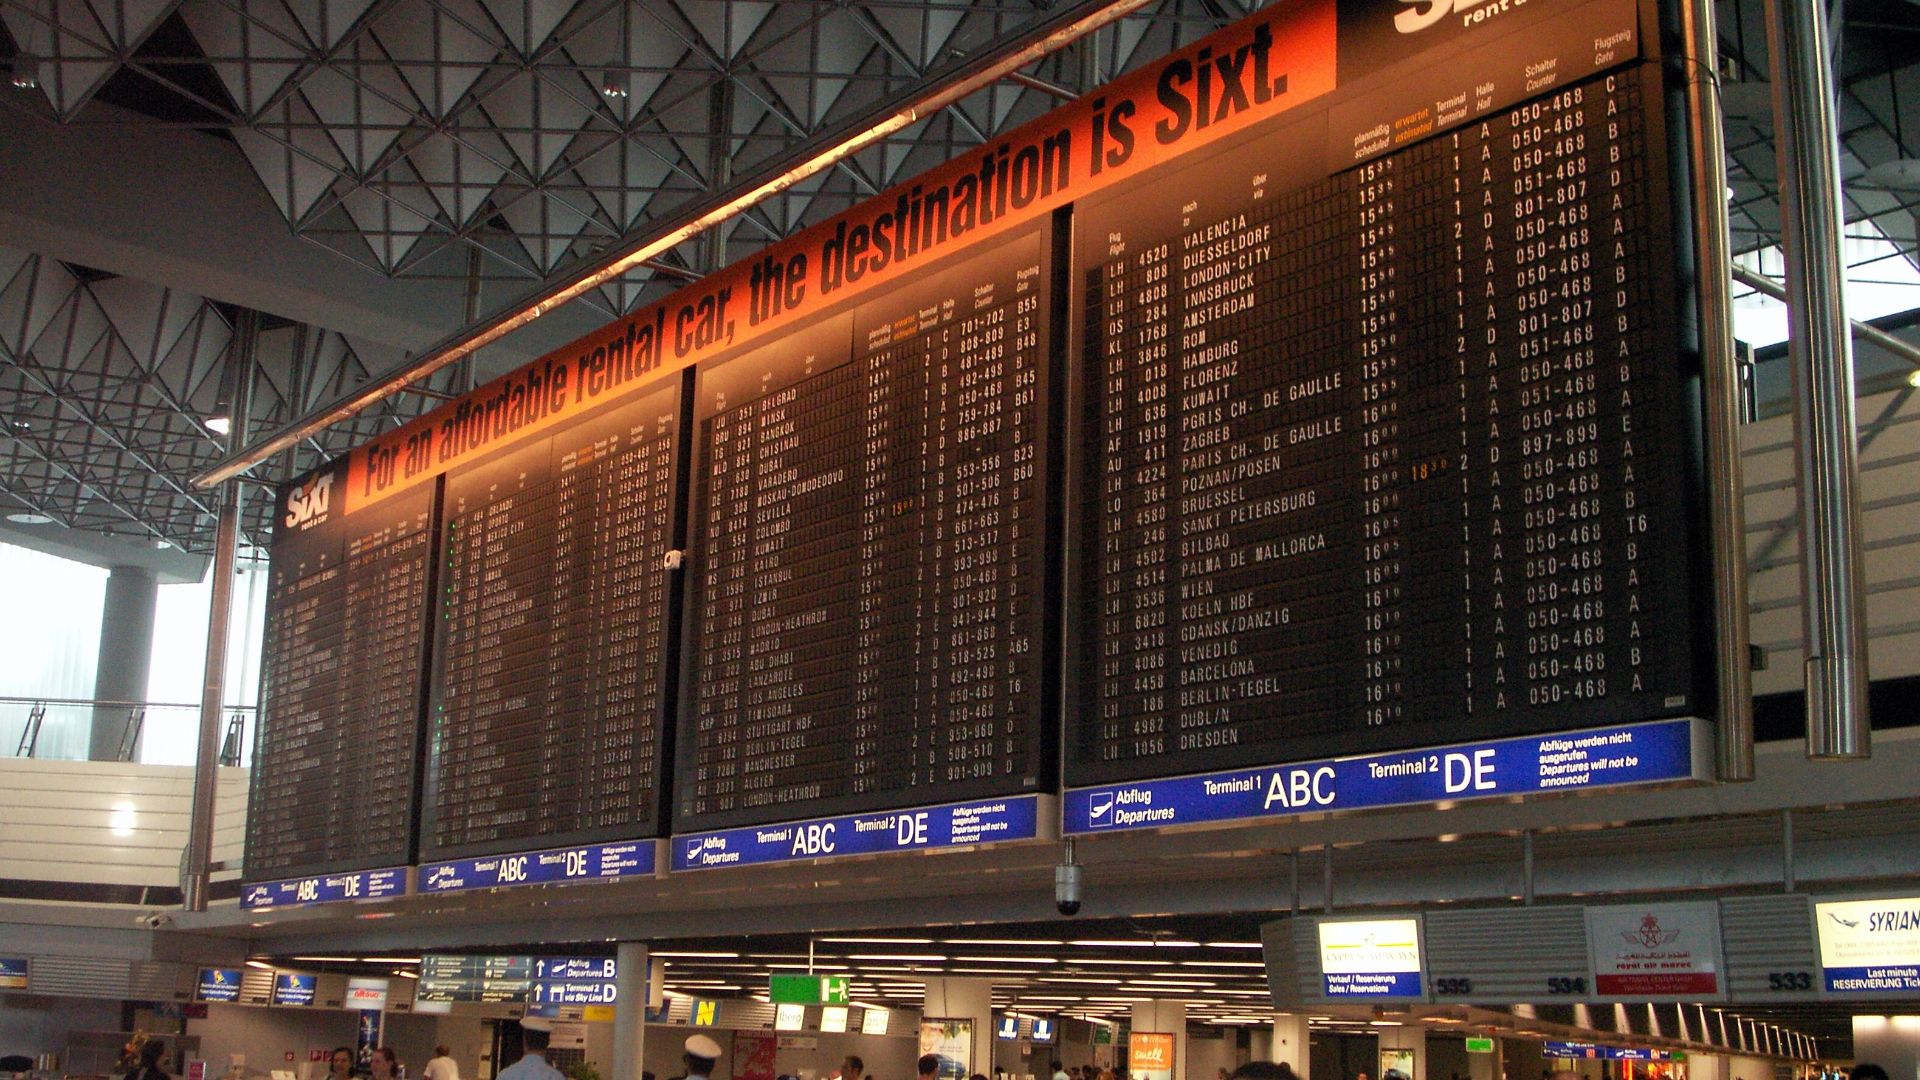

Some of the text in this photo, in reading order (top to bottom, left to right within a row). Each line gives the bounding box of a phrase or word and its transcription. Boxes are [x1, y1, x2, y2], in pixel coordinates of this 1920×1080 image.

[1594, 29, 1632, 50] Flugsteig
[1526, 58, 1557, 78] Schalter
[1595, 50, 1614, 66] Gate
[1476, 81, 1495, 98] Halle
[1526, 72, 1556, 92] Counter
[1436, 92, 1466, 113] Terminal
[1476, 97, 1492, 112] Hall
[1395, 108, 1429, 129] erwartet
[1437, 106, 1468, 128] Terminal
[1110, 76, 1616, 278] LH 4520 VALENCIA 050-468 C
[365, 22, 1288, 497] For an affordable rental car, the destination is Sixt.
[1110, 225, 1271, 297] LH 808 DUESSELDORF
[1183, 170, 1620, 329] AMSTERDAM 801-807 D
[1184, 247, 1271, 290] LONDON-CITY
[1185, 273, 1255, 309] INNSBRUCK
[1183, 330, 1206, 350] ROM
[762, 296, 1037, 411] BELGRAD 701-702 B55
[1183, 341, 1238, 370] HAMBURG
[1183, 362, 1238, 390] FLORENZ
[1183, 384, 1230, 411] KUWAIT
[1230, 401, 1253, 417] CH.
[1264, 390, 1279, 408] DE
[1289, 373, 1342, 400] GAULLE
[761, 410, 786, 428] MINSK
[760, 421, 795, 444] BANGKOK
[1183, 426, 1230, 452] ZAGREB
[1183, 417, 1342, 472] PARIS CH. DE GAULLE
[758, 468, 798, 491] VARADERO
[1182, 456, 1280, 493] POZNAN/POSEN
[1182, 488, 1245, 515] BRUESSEL
[757, 503, 791, 524] SEVILLA
[1182, 491, 1316, 536] SANKT PETERSBURG
[756, 520, 791, 540] COLOMBO
[1182, 533, 1230, 557] BILBAO
[1182, 534, 1326, 578] PALMA DE MALLORCA
[1181, 579, 1213, 599] WIEN
[1181, 592, 1254, 620] KOELN HBF
[1181, 608, 1290, 642] GDANSK/DANZIG
[1181, 640, 1238, 663] VENEDIG
[1181, 659, 1255, 685] BARCELONA
[1181, 678, 1280, 706] BERLIN-TEGEL
[1181, 728, 1238, 750] DRESDEN
[1540, 732, 1632, 752] Abflüge werden nicht
[1540, 750, 1587, 764] ausgerufen
[1540, 756, 1638, 776] Departures will not be
[1369, 749, 1497, 793] Terminal 2 DE
[1540, 773, 1589, 787] announced
[1116, 789, 1152, 805] Abflug
[1204, 766, 1336, 810] Terminal 1 ABC
[1115, 807, 1174, 825] Departures
[757, 830, 787, 844] Terminal
[792, 823, 836, 856] ABC
[854, 813, 929, 845] Terminal 2 DE
[703, 836, 726, 851] Abflug
[498, 857, 527, 882] ABC
[562, 852, 566, 862] 2
[566, 850, 587, 876] DE
[703, 851, 739, 866] Departures
[297, 880, 319, 901] ABC
[345, 875, 360, 896] DE
[567, 959, 615, 977] Departures B
[568, 960, 590, 969] Abflug
[1867, 968, 1917, 977] Last minute
[1328, 975, 1351, 983] Verkauf
[1356, 974, 1396, 984] Reservierung
[1329, 985, 1345, 993] Sales
[1350, 984, 1388, 993] Reservations
[1548, 977, 1586, 994] 534
[1769, 972, 1811, 990] 533
[1833, 979, 1901, 989] RESERVIERUNG
[566, 984, 616, 1002] Terminal 2 D
[696, 1000, 716, 1025] N
